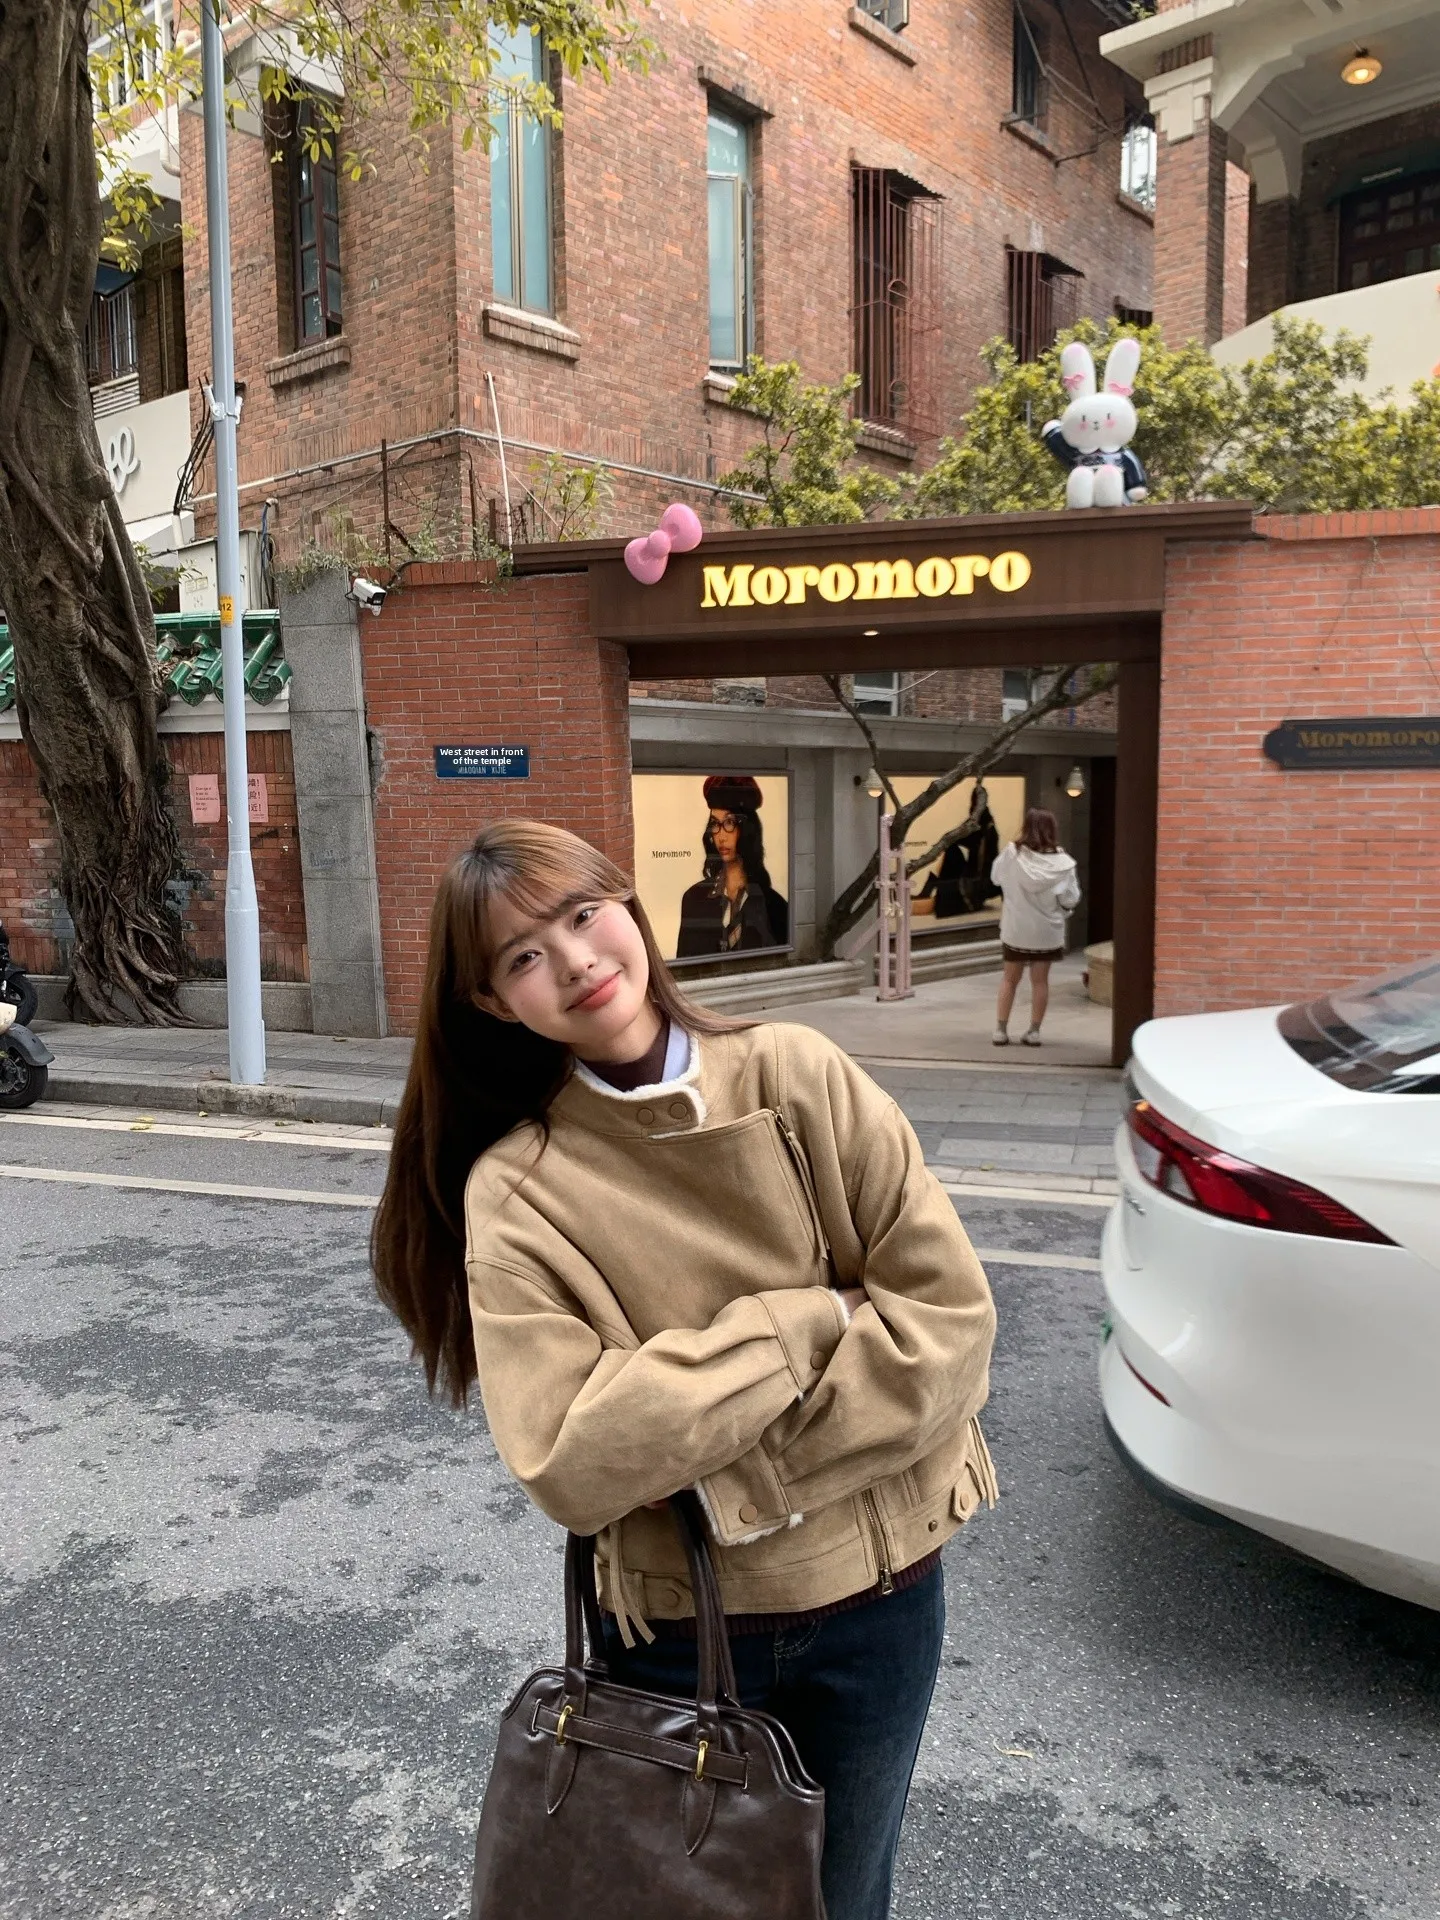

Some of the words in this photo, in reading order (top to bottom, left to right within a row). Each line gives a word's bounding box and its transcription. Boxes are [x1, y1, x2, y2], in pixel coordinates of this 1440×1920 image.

[700, 551, 1031, 608] Moromoro
[1297, 729, 1440, 748] Moromoro
[440, 748, 461, 756] West
[463, 748, 488, 756] street
[491, 748, 499, 756] in
[500, 748, 524, 756] front
[453, 757, 464, 765] of
[464, 757, 478, 765] the
[481, 757, 511, 766] temple
[652, 850, 692, 859] Moromoro
